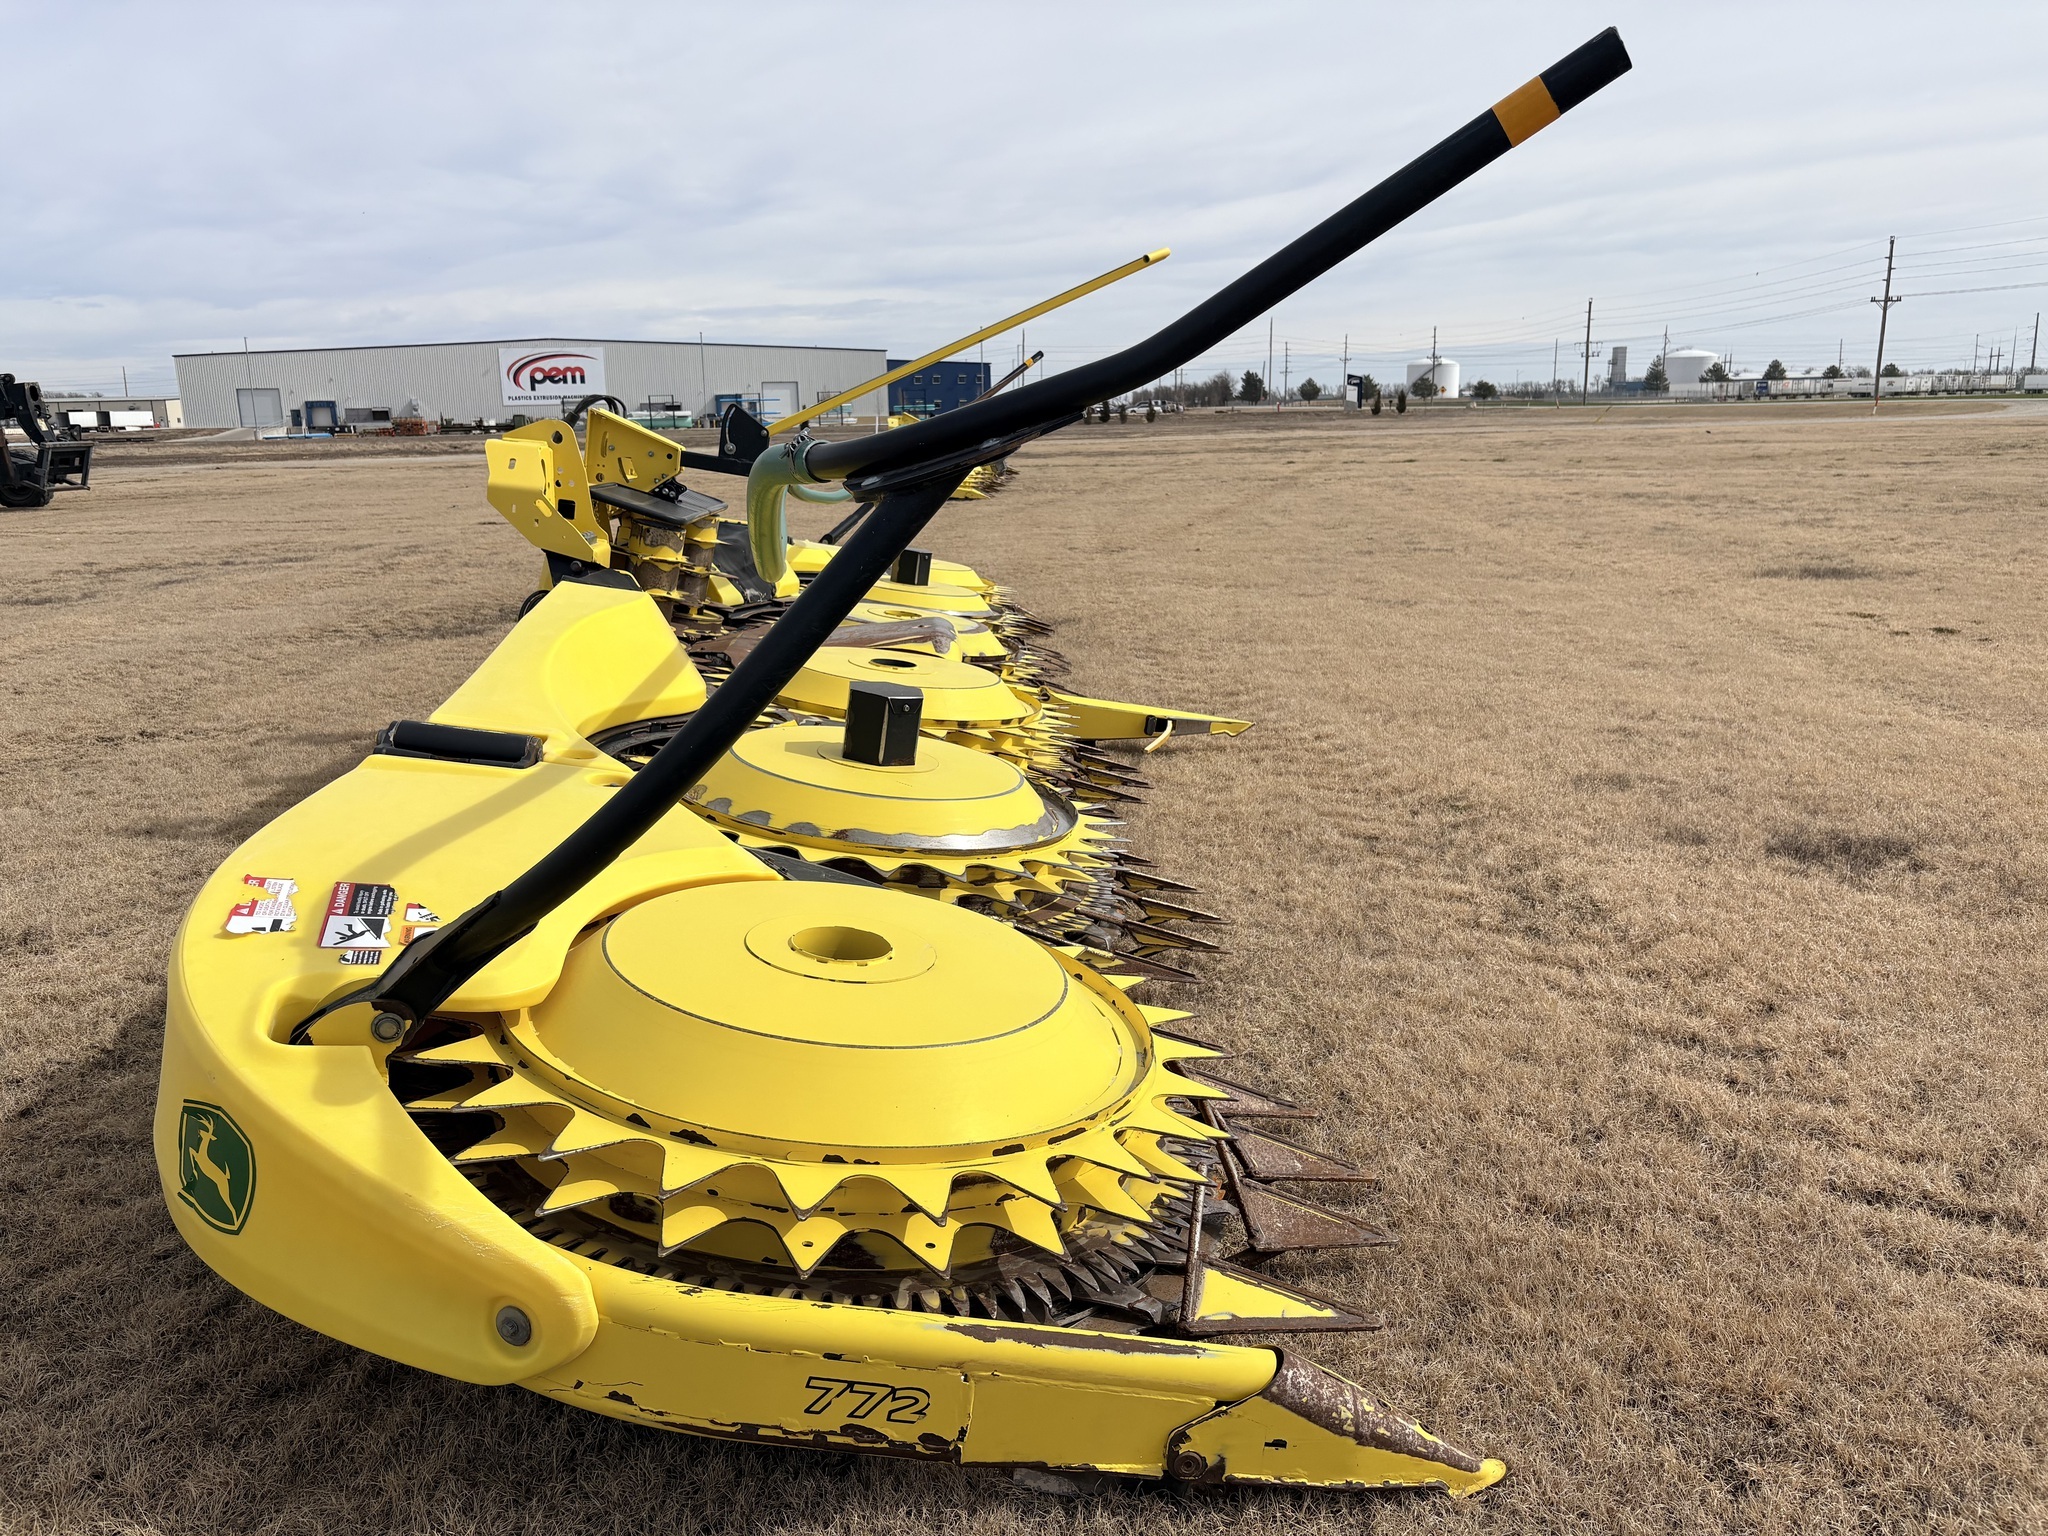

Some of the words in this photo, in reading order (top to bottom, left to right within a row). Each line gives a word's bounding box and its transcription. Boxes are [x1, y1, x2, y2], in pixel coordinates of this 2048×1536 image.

[530, 367, 586, 391] pem
[334, 883, 351, 908] DANGER
[803, 1376, 931, 1424] 772
